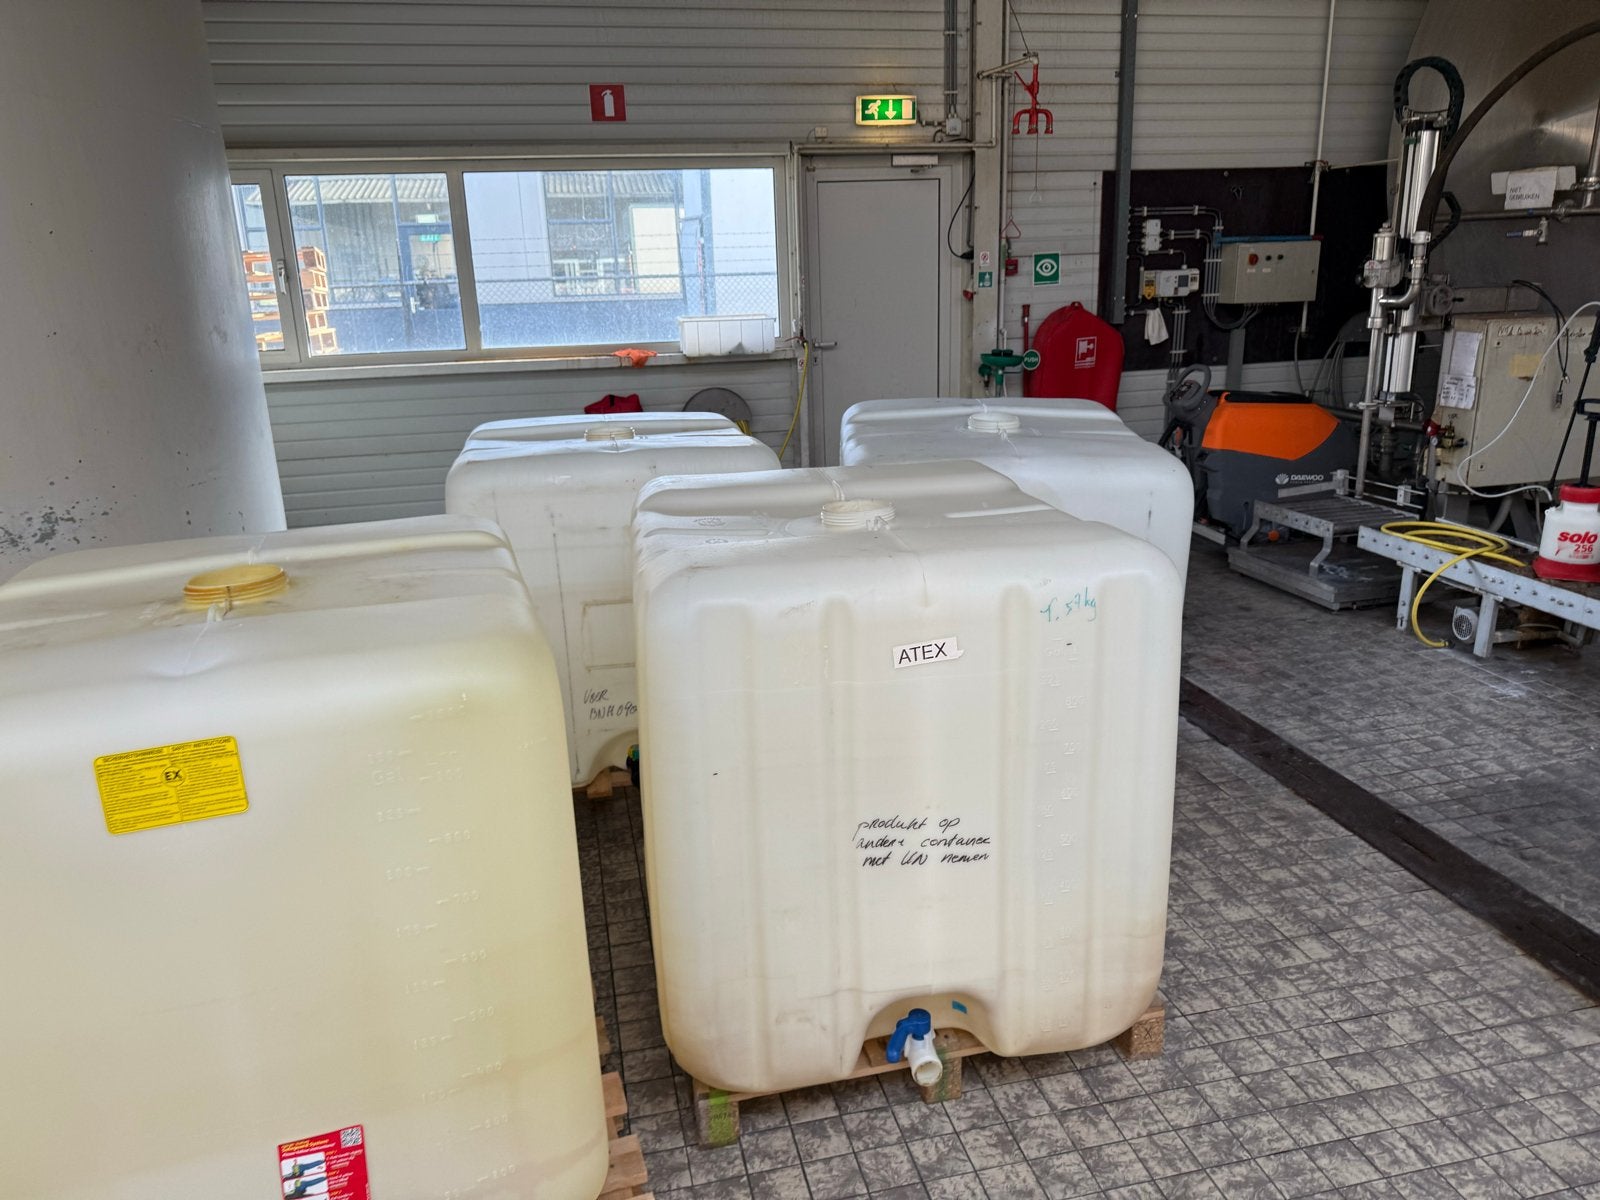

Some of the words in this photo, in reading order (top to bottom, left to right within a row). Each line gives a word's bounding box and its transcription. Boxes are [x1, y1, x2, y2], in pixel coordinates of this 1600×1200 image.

[1557, 531, 1598, 544] solo
[1574, 543, 1593, 553] 256
[898, 642, 947, 664] ATEX
[164, 769, 182, 780] EX
[852, 815, 928, 841] produkt
[939, 817, 960, 833] op
[862, 851, 892, 866] met
